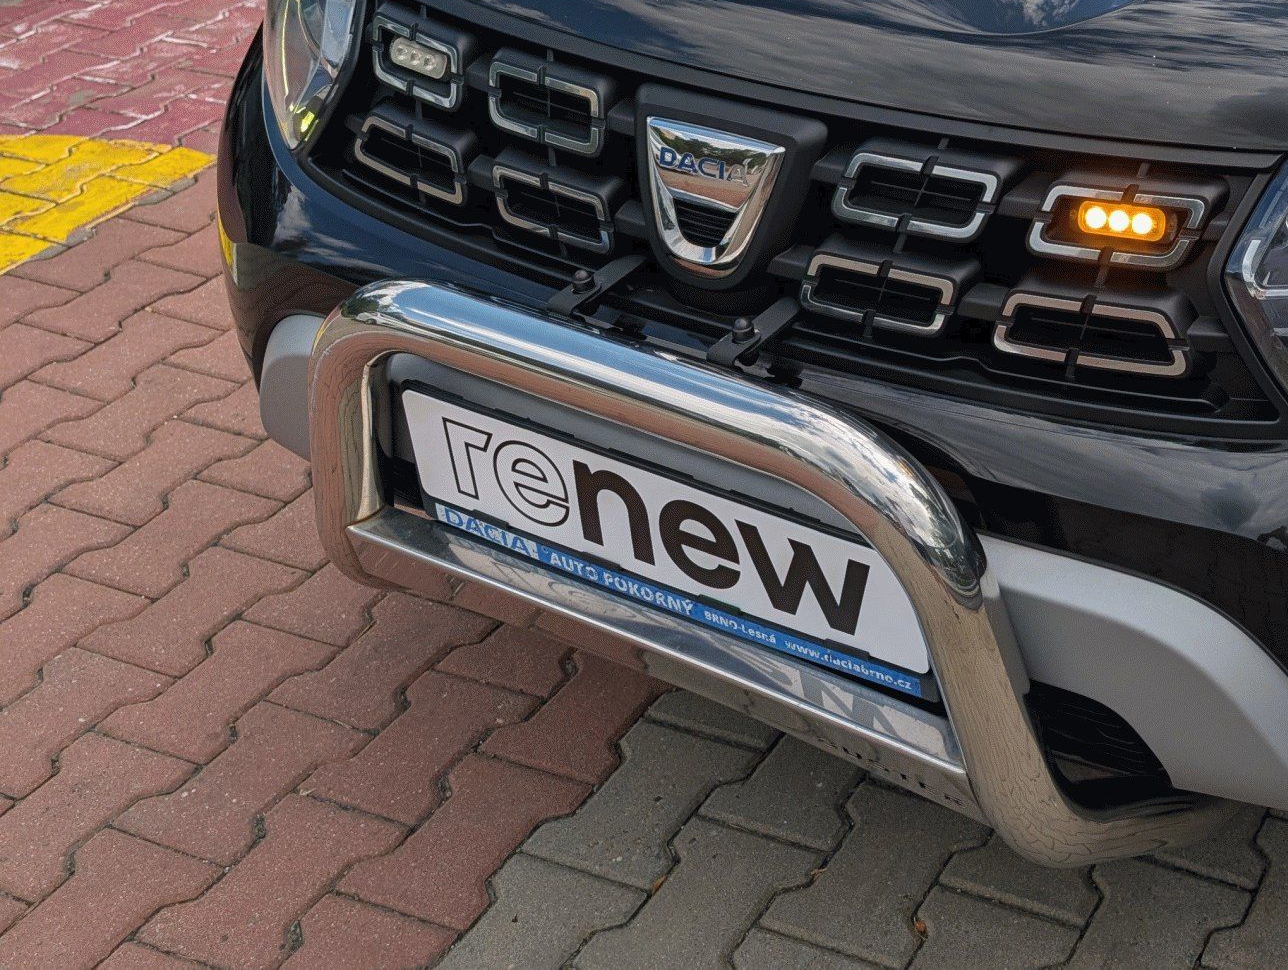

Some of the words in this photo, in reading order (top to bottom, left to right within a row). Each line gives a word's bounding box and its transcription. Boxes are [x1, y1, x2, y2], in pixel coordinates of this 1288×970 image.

[659, 145, 749, 187] DACIA
[442, 416, 871, 636] renew
[445, 506, 532, 557] DACIA
[549, 548, 600, 582] AUTO
[602, 570, 694, 617] POKORNÝ
